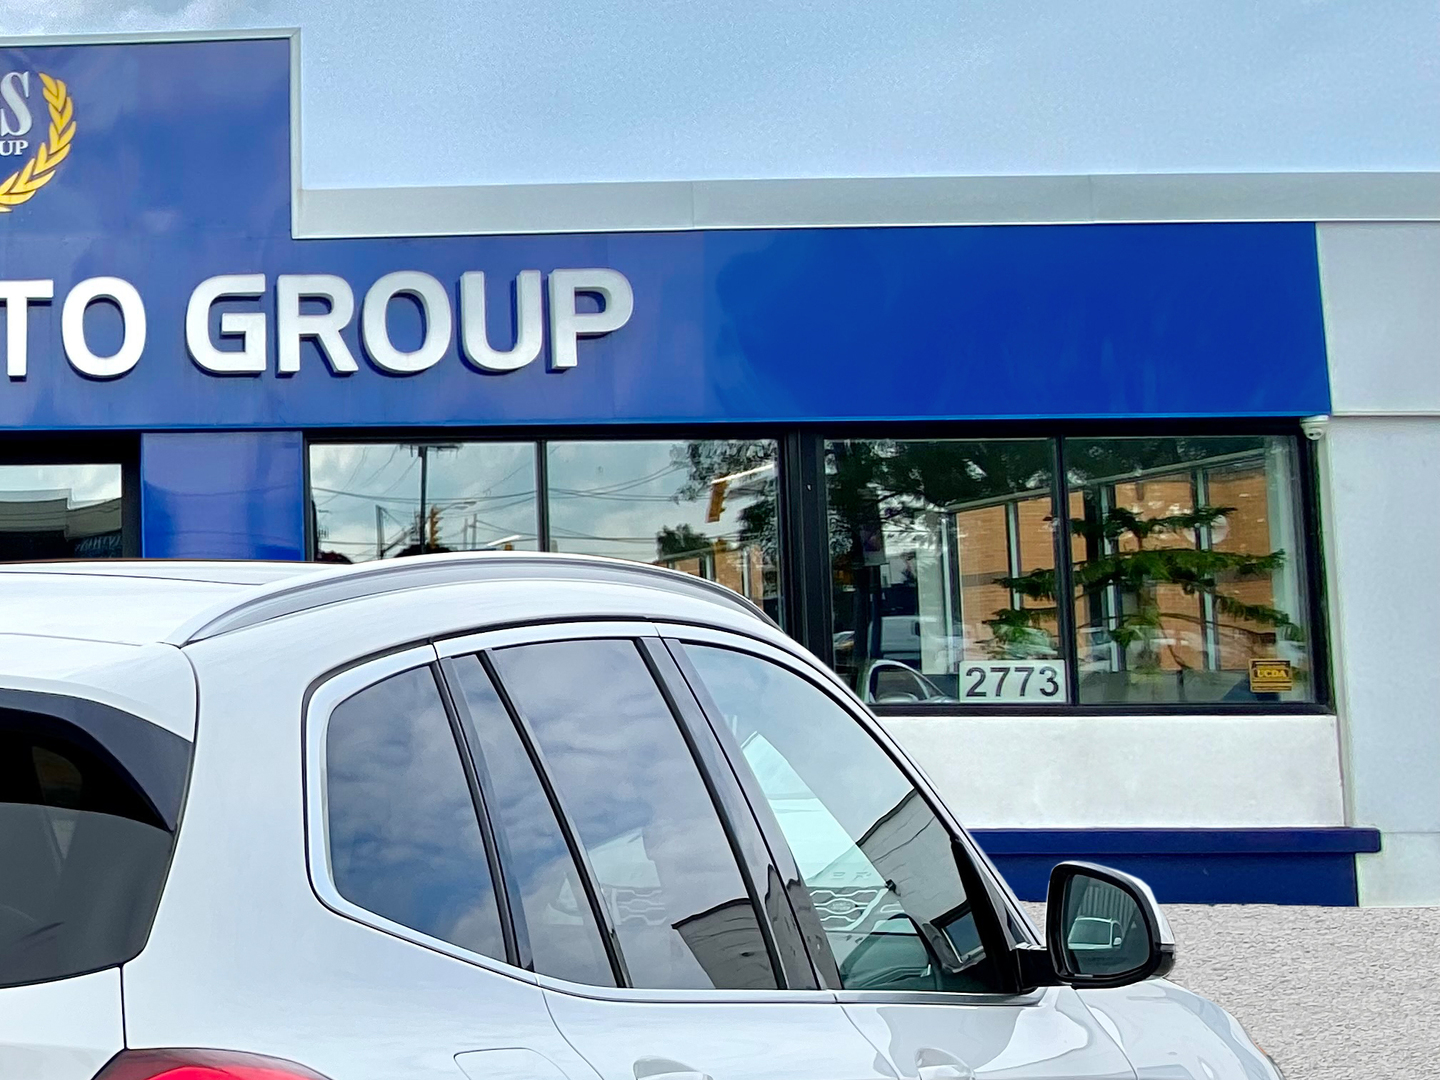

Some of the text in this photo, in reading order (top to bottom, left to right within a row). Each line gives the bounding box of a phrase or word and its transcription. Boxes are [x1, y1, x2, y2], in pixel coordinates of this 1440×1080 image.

[185, 269, 635, 374] GROUP
[965, 666, 1059, 697] 2773
[1257, 669, 1287, 677] UCDA
